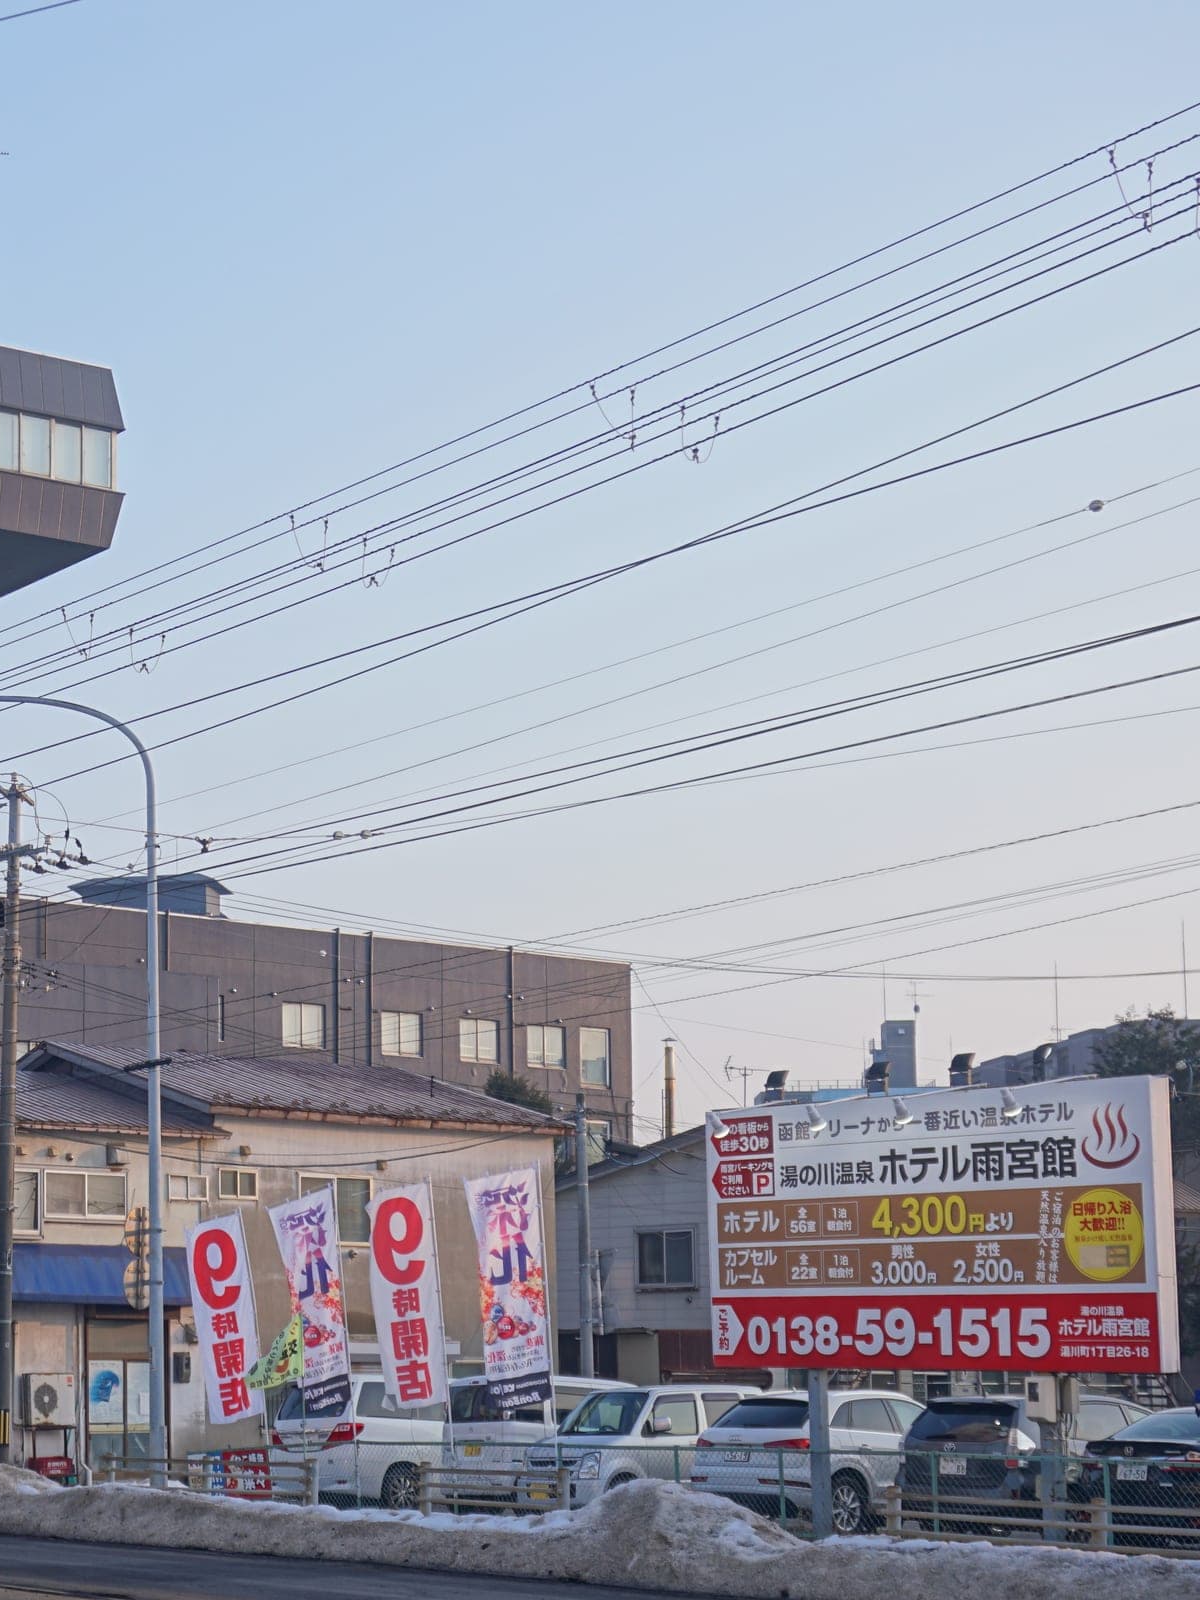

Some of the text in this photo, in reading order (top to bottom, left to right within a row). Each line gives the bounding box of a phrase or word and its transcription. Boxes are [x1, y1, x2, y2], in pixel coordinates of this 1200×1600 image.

[727, 1122, 769, 1135] の看板から
[779, 1136, 1078, 1189] 湯の川温泉 ホテル雨宮館
[798, 1206, 808, 1219] 全
[1072, 1200, 1133, 1217] 日帰り入浴
[723, 1210, 780, 1234] ホテル
[891, 1244, 915, 1259] 男性
[975, 1242, 1001, 1257] 女性
[799, 1253, 809, 1265] 全
[725, 1268, 765, 1286] ルーム
[718, 1308, 730, 1352] ご予約
[747, 1307, 1051, 1358] 0138-59-1515
[1058, 1318, 1150, 1337] ホテル雨宮館
